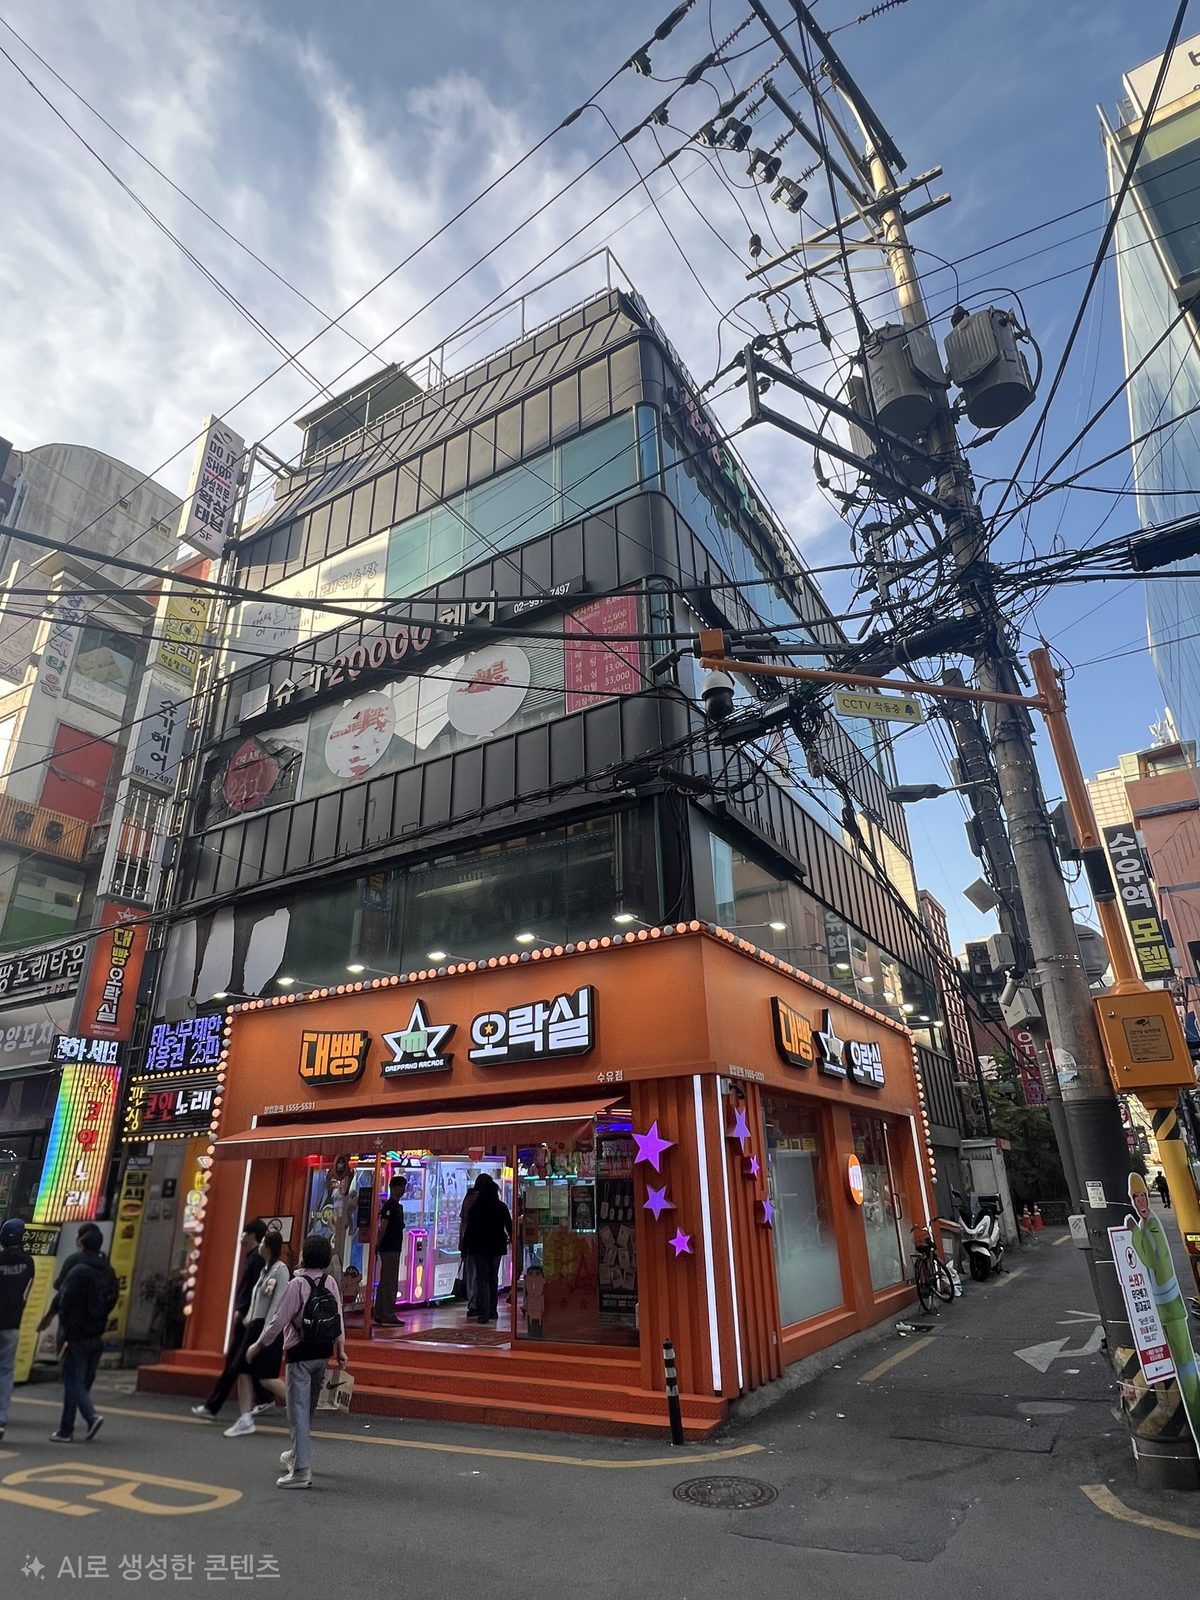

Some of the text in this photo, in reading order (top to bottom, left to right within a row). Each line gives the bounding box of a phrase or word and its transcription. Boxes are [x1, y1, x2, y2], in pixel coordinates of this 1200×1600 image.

[209, 440, 223, 458] DO
[194, 503, 222, 533] 태닝
[161, 635, 198, 664] 노래
[604, 671, 630, 686] 33,000
[842, 698, 901, 714] CCTV 작동중
[150, 699, 178, 771] 슈가헤어
[135, 765, 174, 786] 991-7497
[1109, 831, 1153, 909] 수유역
[1130, 915, 1172, 973] 모텔
[96, 927, 135, 1023] 대빵오락실
[469, 987, 592, 1060] 오락실
[778, 1001, 814, 1062] 대빵
[300, 1031, 364, 1079] 대빵
[850, 1040, 885, 1085] 오락실
[597, 1069, 623, 1083] 수유점
[23, 1242, 50, 1255] 수유점
